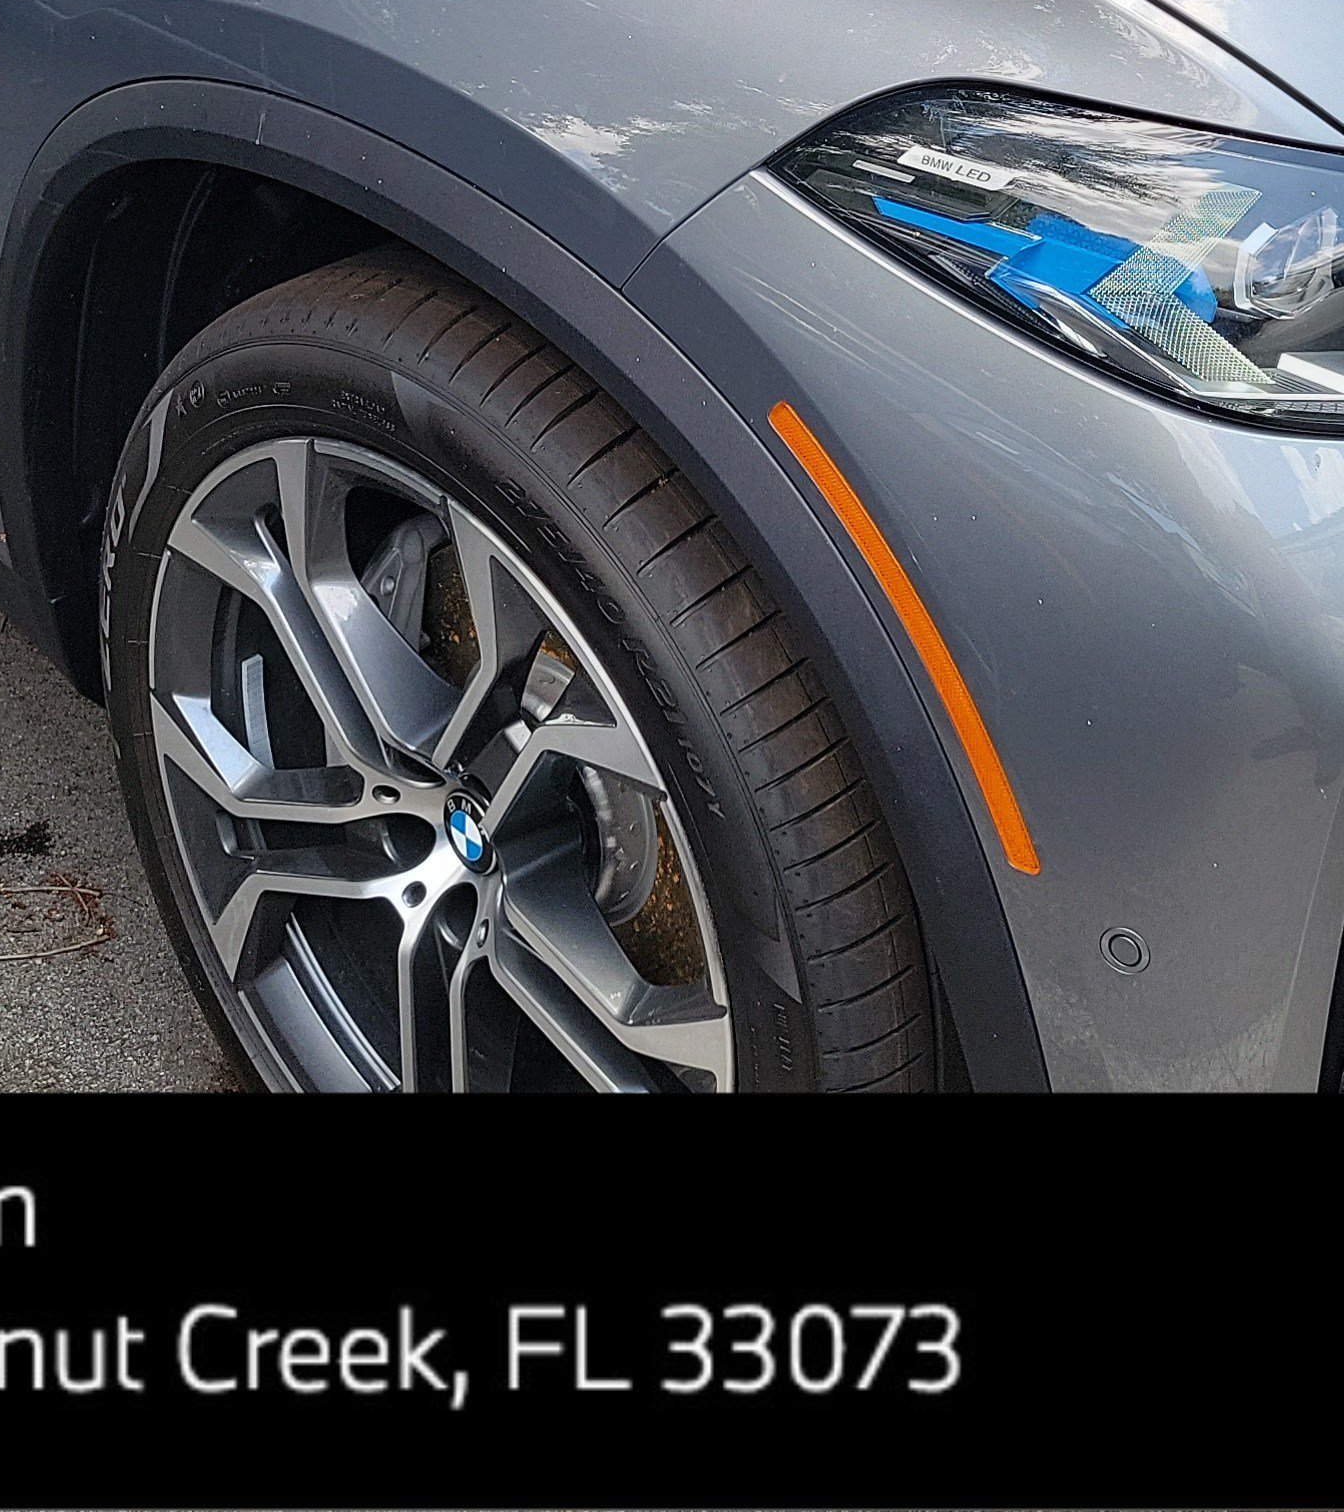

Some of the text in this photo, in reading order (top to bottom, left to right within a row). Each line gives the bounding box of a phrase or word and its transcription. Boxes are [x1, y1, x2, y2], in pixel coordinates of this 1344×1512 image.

[922, 155, 991, 183] BMW LED
[494, 477, 626, 625] 275/40
